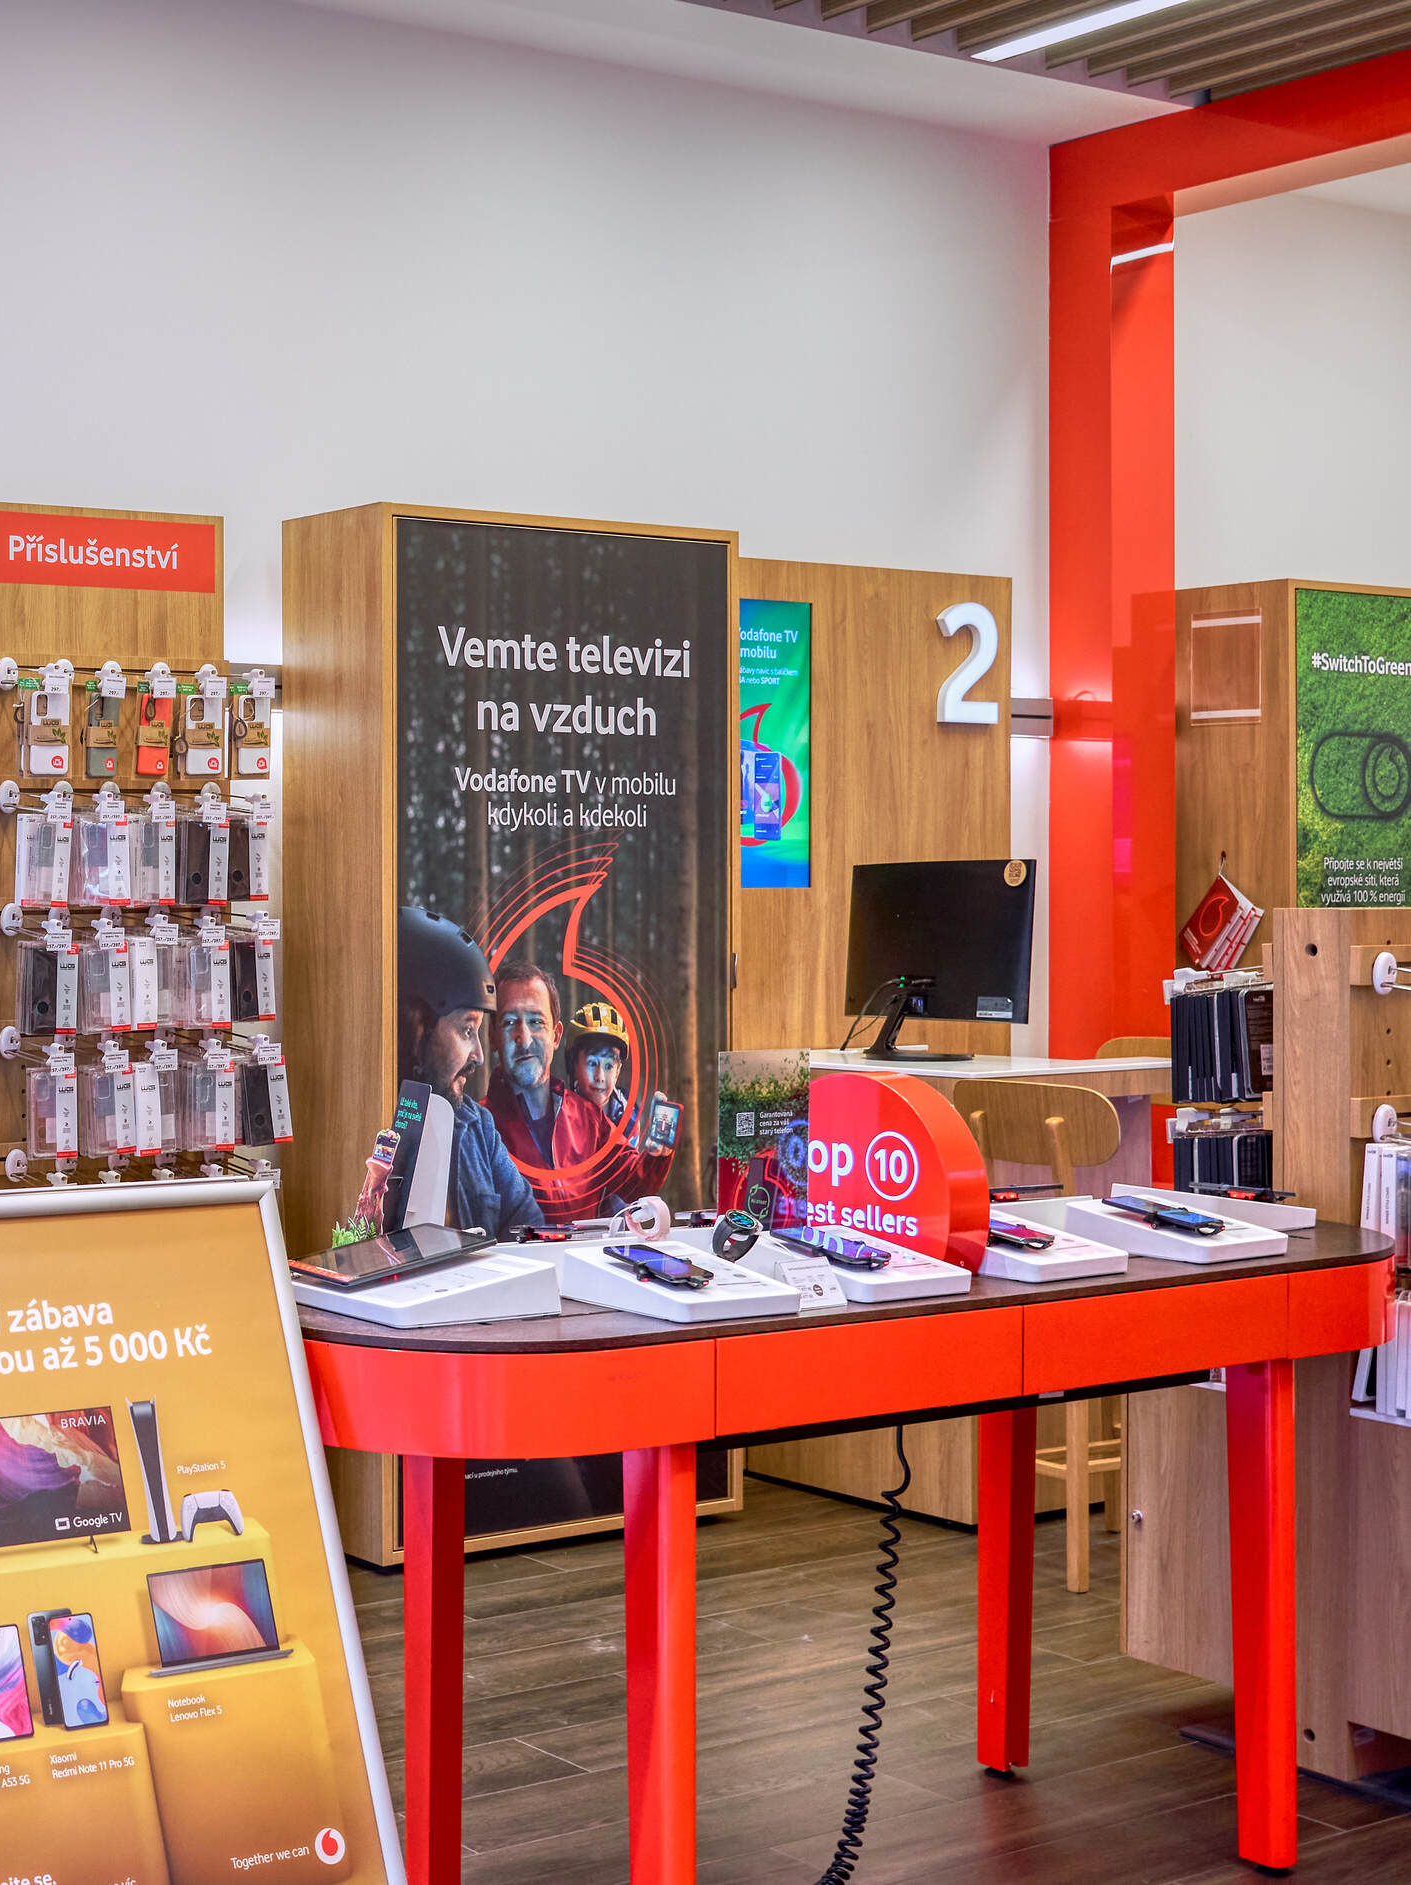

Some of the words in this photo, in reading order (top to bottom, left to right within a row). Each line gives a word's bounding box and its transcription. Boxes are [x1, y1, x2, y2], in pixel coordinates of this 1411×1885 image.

[8, 534, 178, 570] Příslušenství
[783, 629, 799, 643] TV
[438, 625, 557, 672] Vemte
[566, 635, 690, 678] televizi
[740, 645, 776, 659] mobilu
[936, 602, 999, 724] 2
[1311, 652, 1411, 676] #SwitchToGreen
[477, 700, 519, 732] na
[530, 695, 657, 736] vzduch
[455, 766, 557, 793] Vodafone
[561, 769, 591, 794] TV
[595, 775, 607, 793] v
[611, 771, 676, 796] mobilu
[488, 801, 557, 832] kdykoli
[563, 808, 573, 826] a
[579, 803, 647, 828] kdekoli
[1356, 859, 1365, 870] se
[1366, 857, 1372, 870] k
[1328, 874, 1363, 888] evropské
[1379, 873, 1400, 886] která
[1353, 890, 1368, 903] 100
[1369, 890, 1378, 903] %
[807, 1138, 854, 1186] op
[873, 1147, 909, 1184] 10
[806, 1199, 836, 1226] est
[840, 1203, 919, 1237] sellers
[7, 1299, 114, 1333] zábava
[42, 1336, 78, 1371] až
[85, 1336, 103, 1367] 5
[109, 1330, 167, 1364] 000
[174, 1324, 213, 1358] Kč
[60, 1414, 107, 1430] BRAVIA
[177, 1463, 219, 1476] PlayStation
[219, 1461, 227, 1471] 5
[73, 1514, 109, 1529] Google
[109, 1512, 124, 1525] TV
[167, 1694, 206, 1709] Notebook
[170, 1710, 199, 1723] Lenovo
[199, 1706, 216, 1718] Flex
[216, 1705, 223, 1715] 5
[49, 1752, 78, 1766] Xiaomi
[52, 1765, 78, 1779] Redmi
[78, 1763, 98, 1776] Note
[98, 1761, 108, 1771] 11
[109, 1759, 123, 1770] Pro
[123, 1756, 135, 1768] 5G
[1, 1776, 18, 1789] A53
[18, 1774, 31, 1786] 5G
[231, 1850, 275, 1871] Together
[275, 1849, 292, 1862] we
[292, 1845, 310, 1858] can
